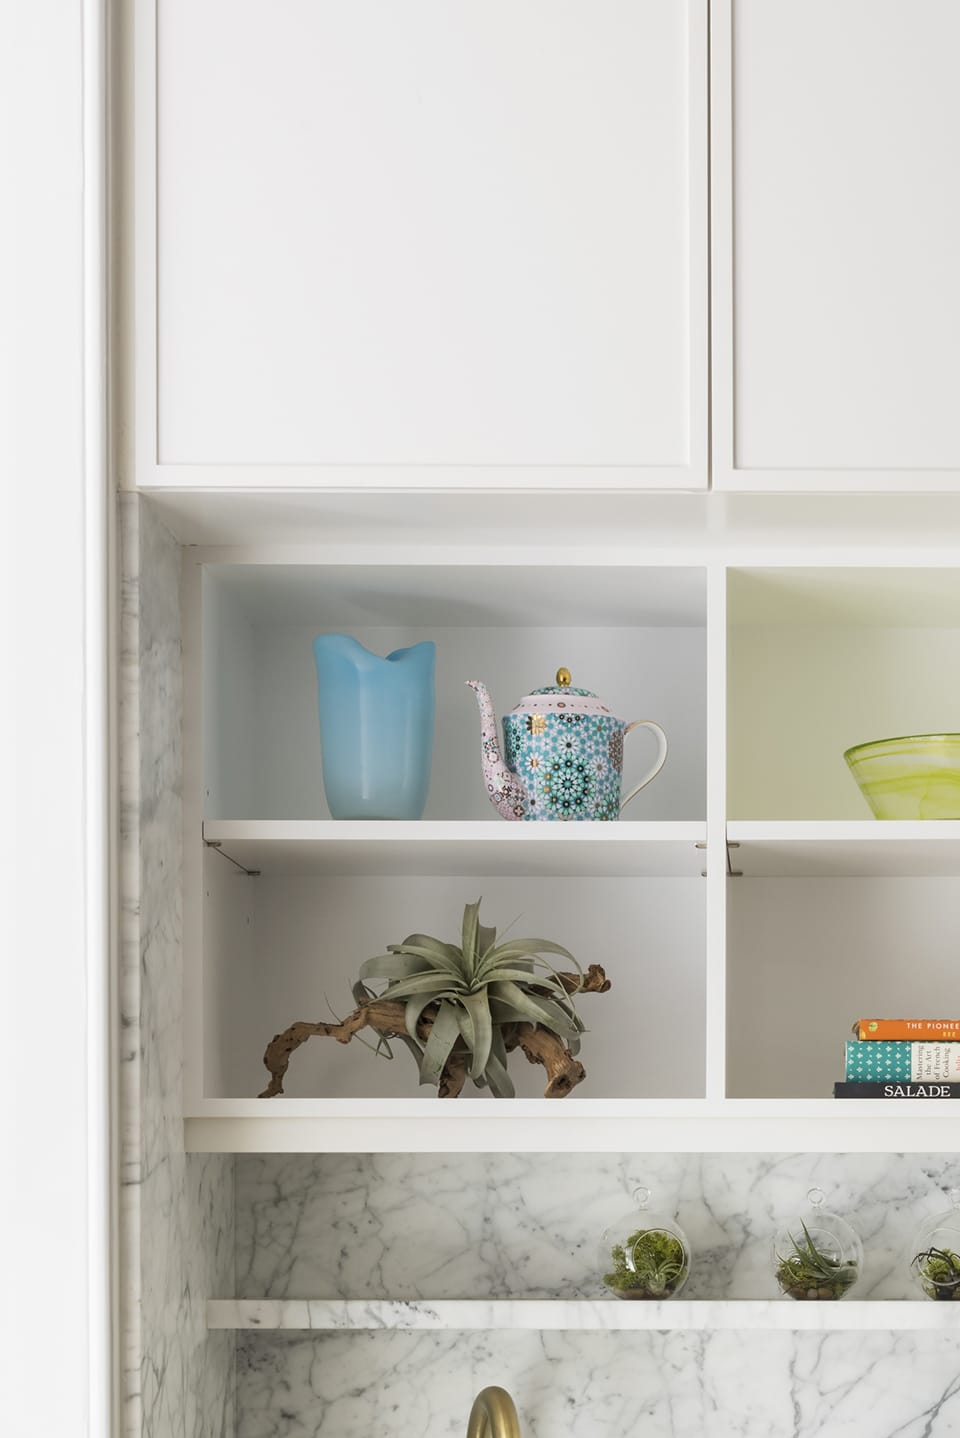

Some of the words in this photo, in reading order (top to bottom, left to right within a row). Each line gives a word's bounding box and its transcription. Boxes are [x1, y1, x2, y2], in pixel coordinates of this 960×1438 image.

[916, 1045, 925, 1080] Mastering
[943, 1047, 951, 1078] Cooking
[884, 1086, 950, 1097] SALADE
